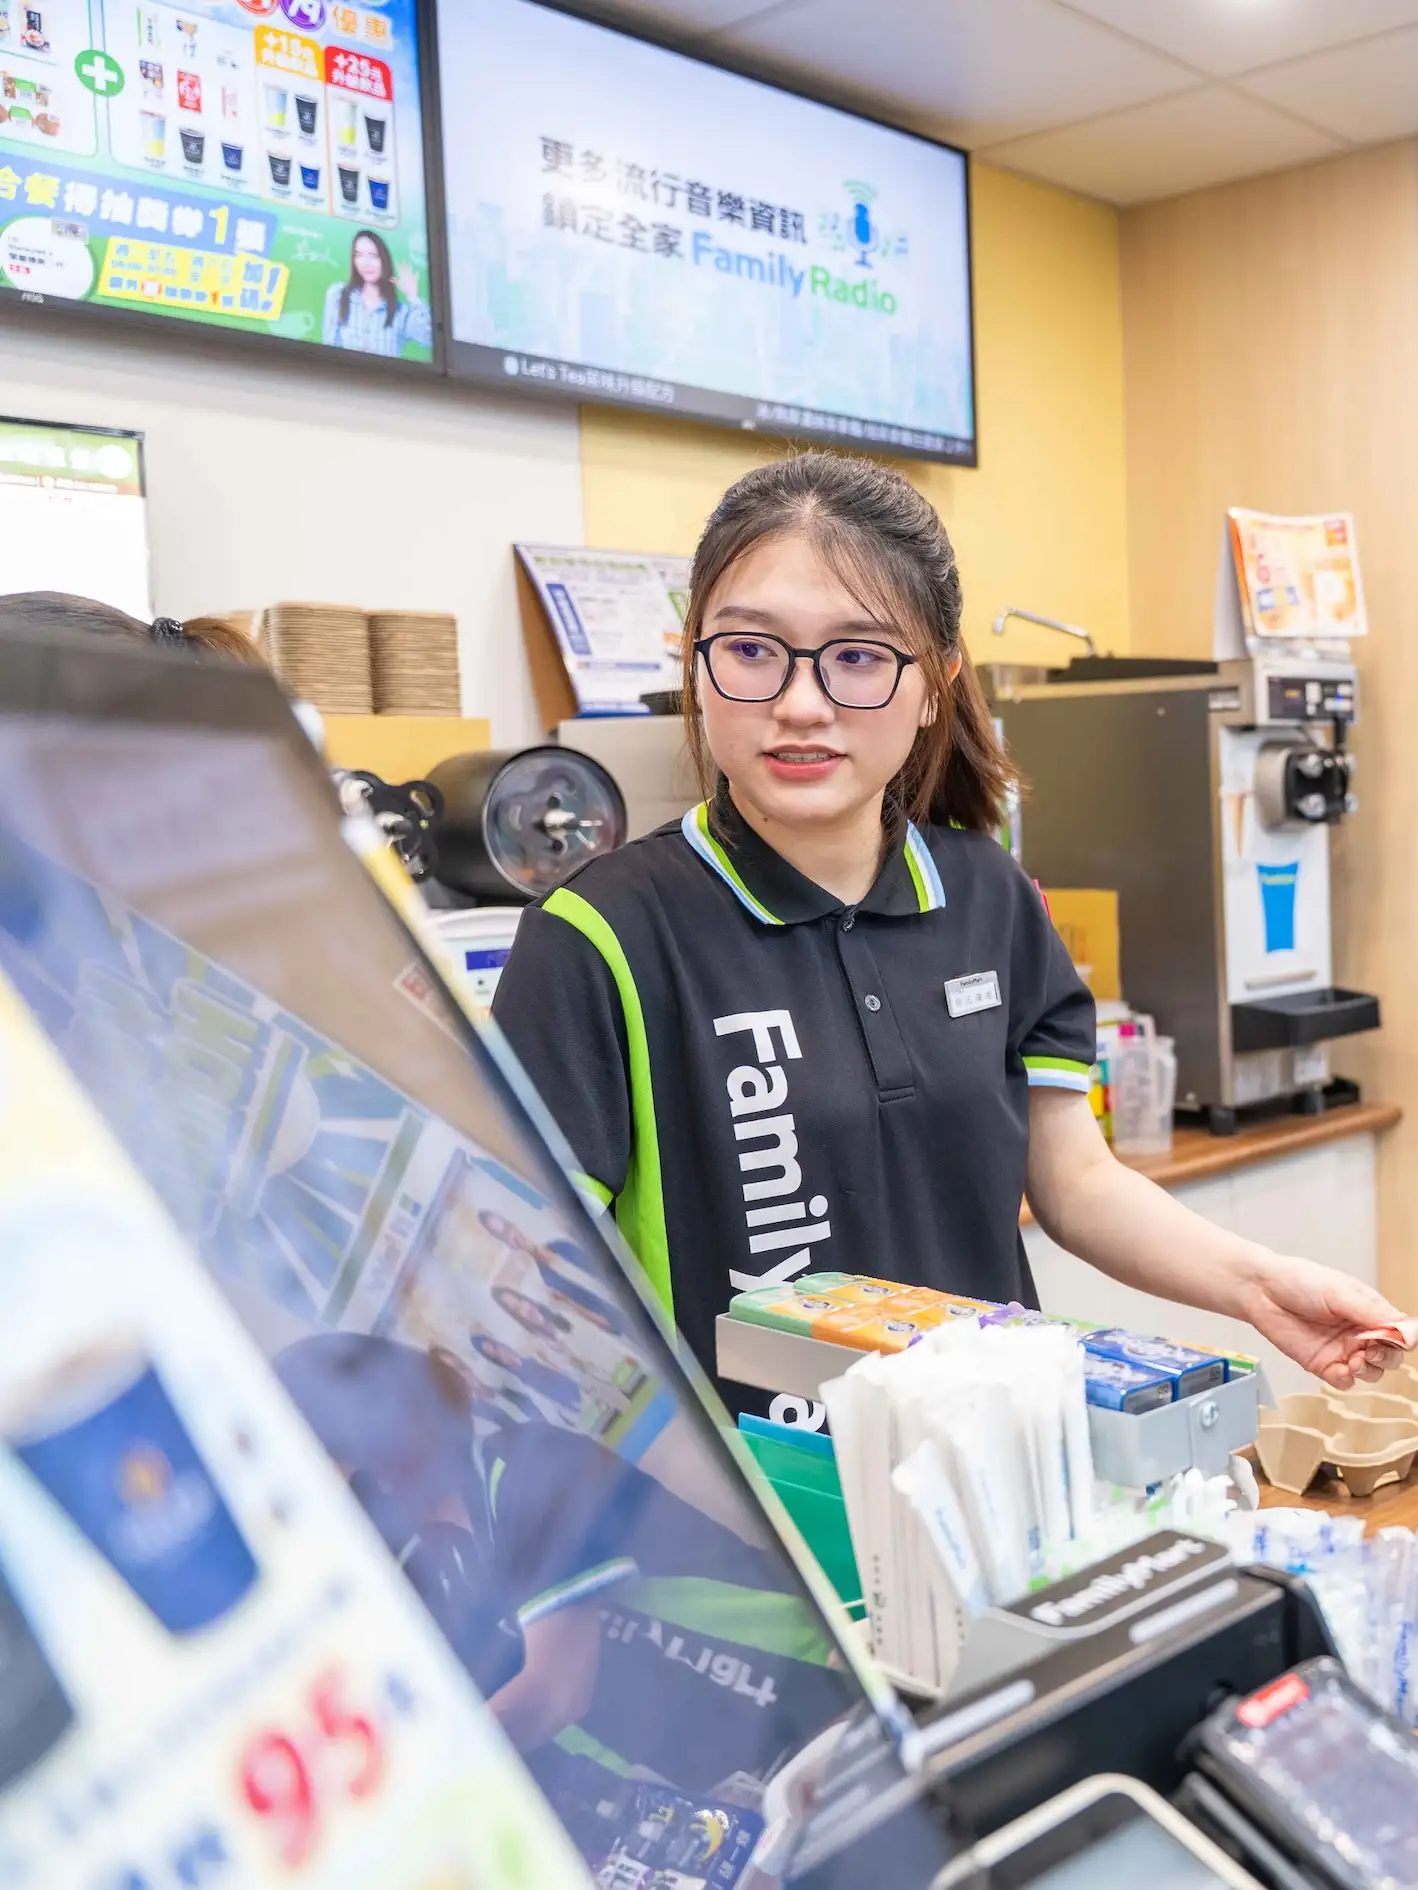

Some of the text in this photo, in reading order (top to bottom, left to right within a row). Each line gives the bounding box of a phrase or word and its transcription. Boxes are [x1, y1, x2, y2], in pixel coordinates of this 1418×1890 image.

[539, 134, 808, 246] 更多流行音樂資訊
[1030, 1538, 1207, 1627] FamilyMart
